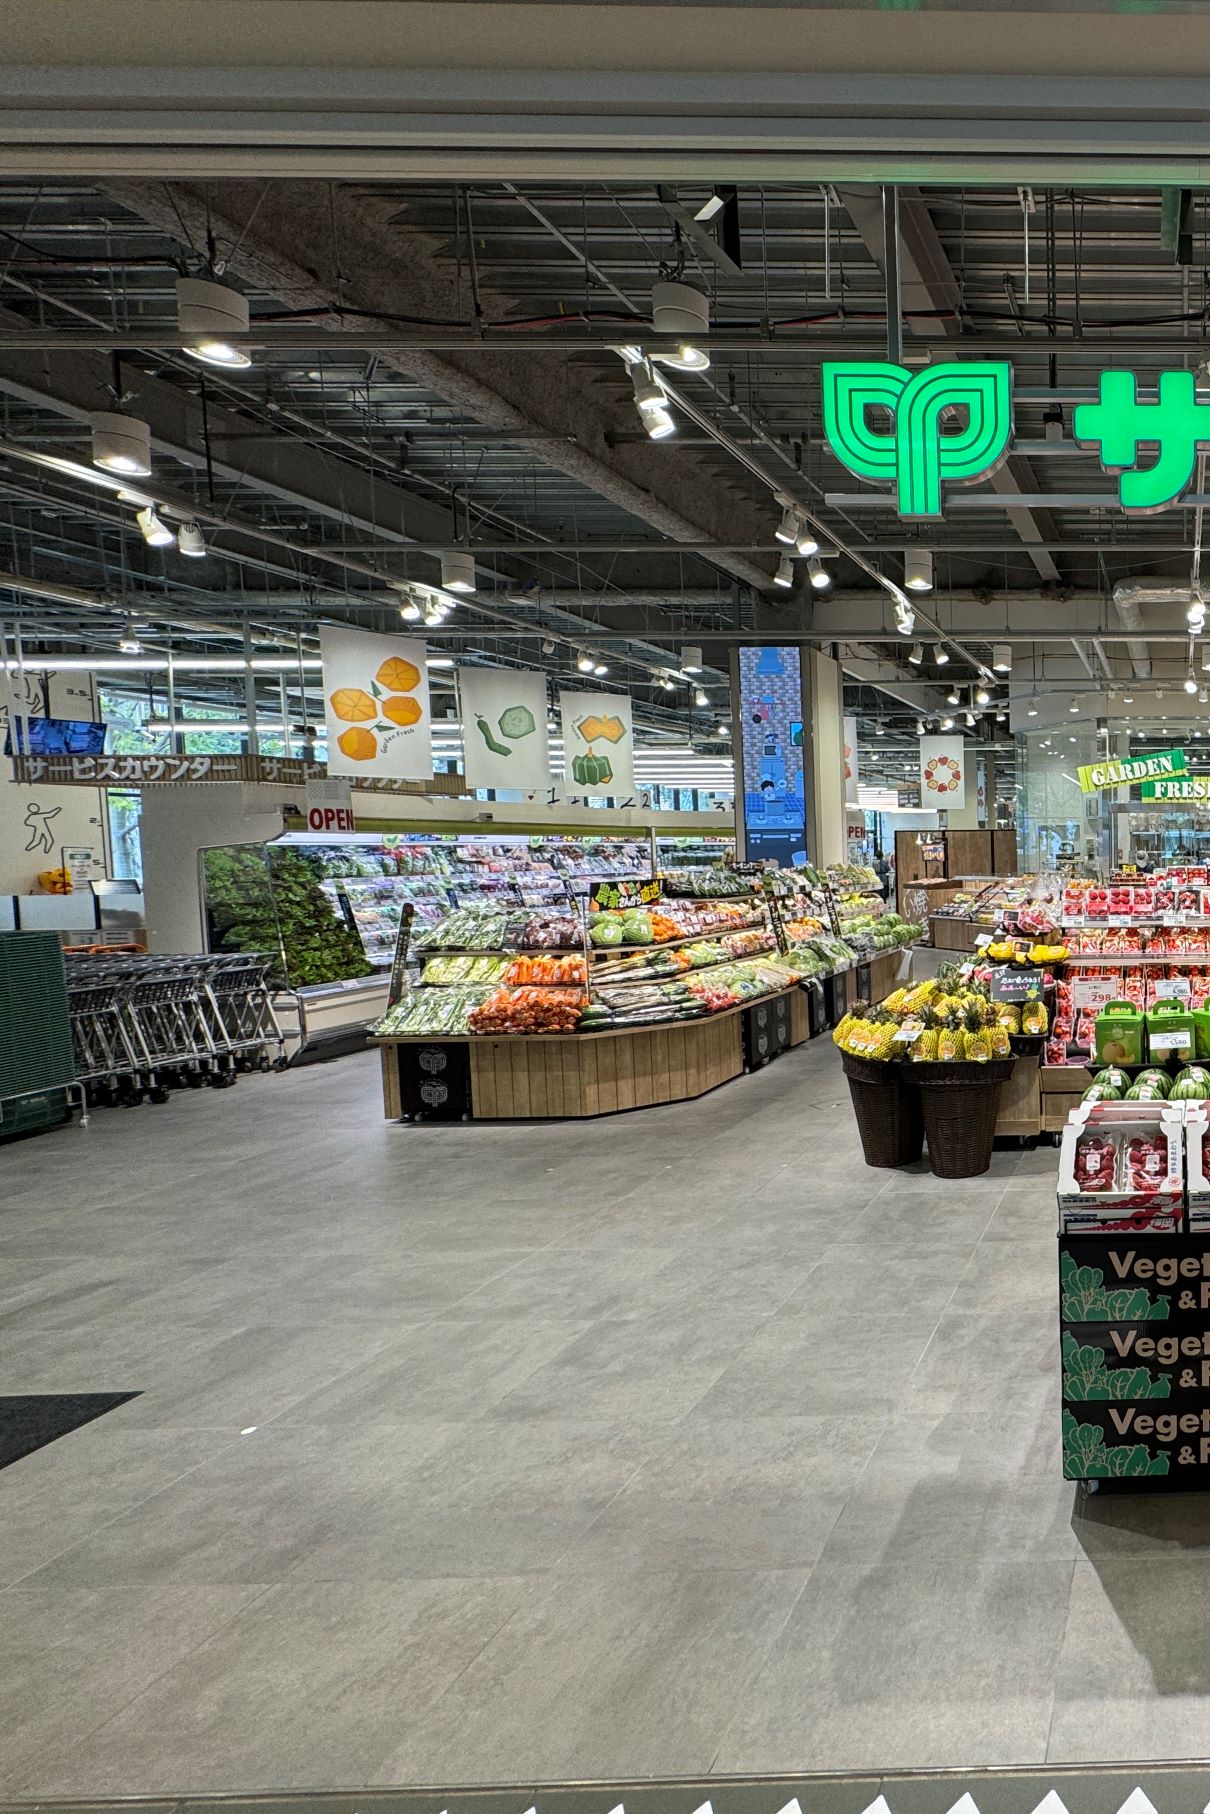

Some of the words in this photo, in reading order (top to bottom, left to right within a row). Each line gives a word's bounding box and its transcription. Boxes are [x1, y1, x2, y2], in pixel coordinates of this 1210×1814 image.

[381, 734, 396, 754] Garden
[396, 728, 415, 738] Fresh
[26, 757, 237, 780] サービスカウンター
[1091, 755, 1173, 786] GARDEN
[309, 808, 355, 831] OPEN
[848, 825, 866, 838] PEN
